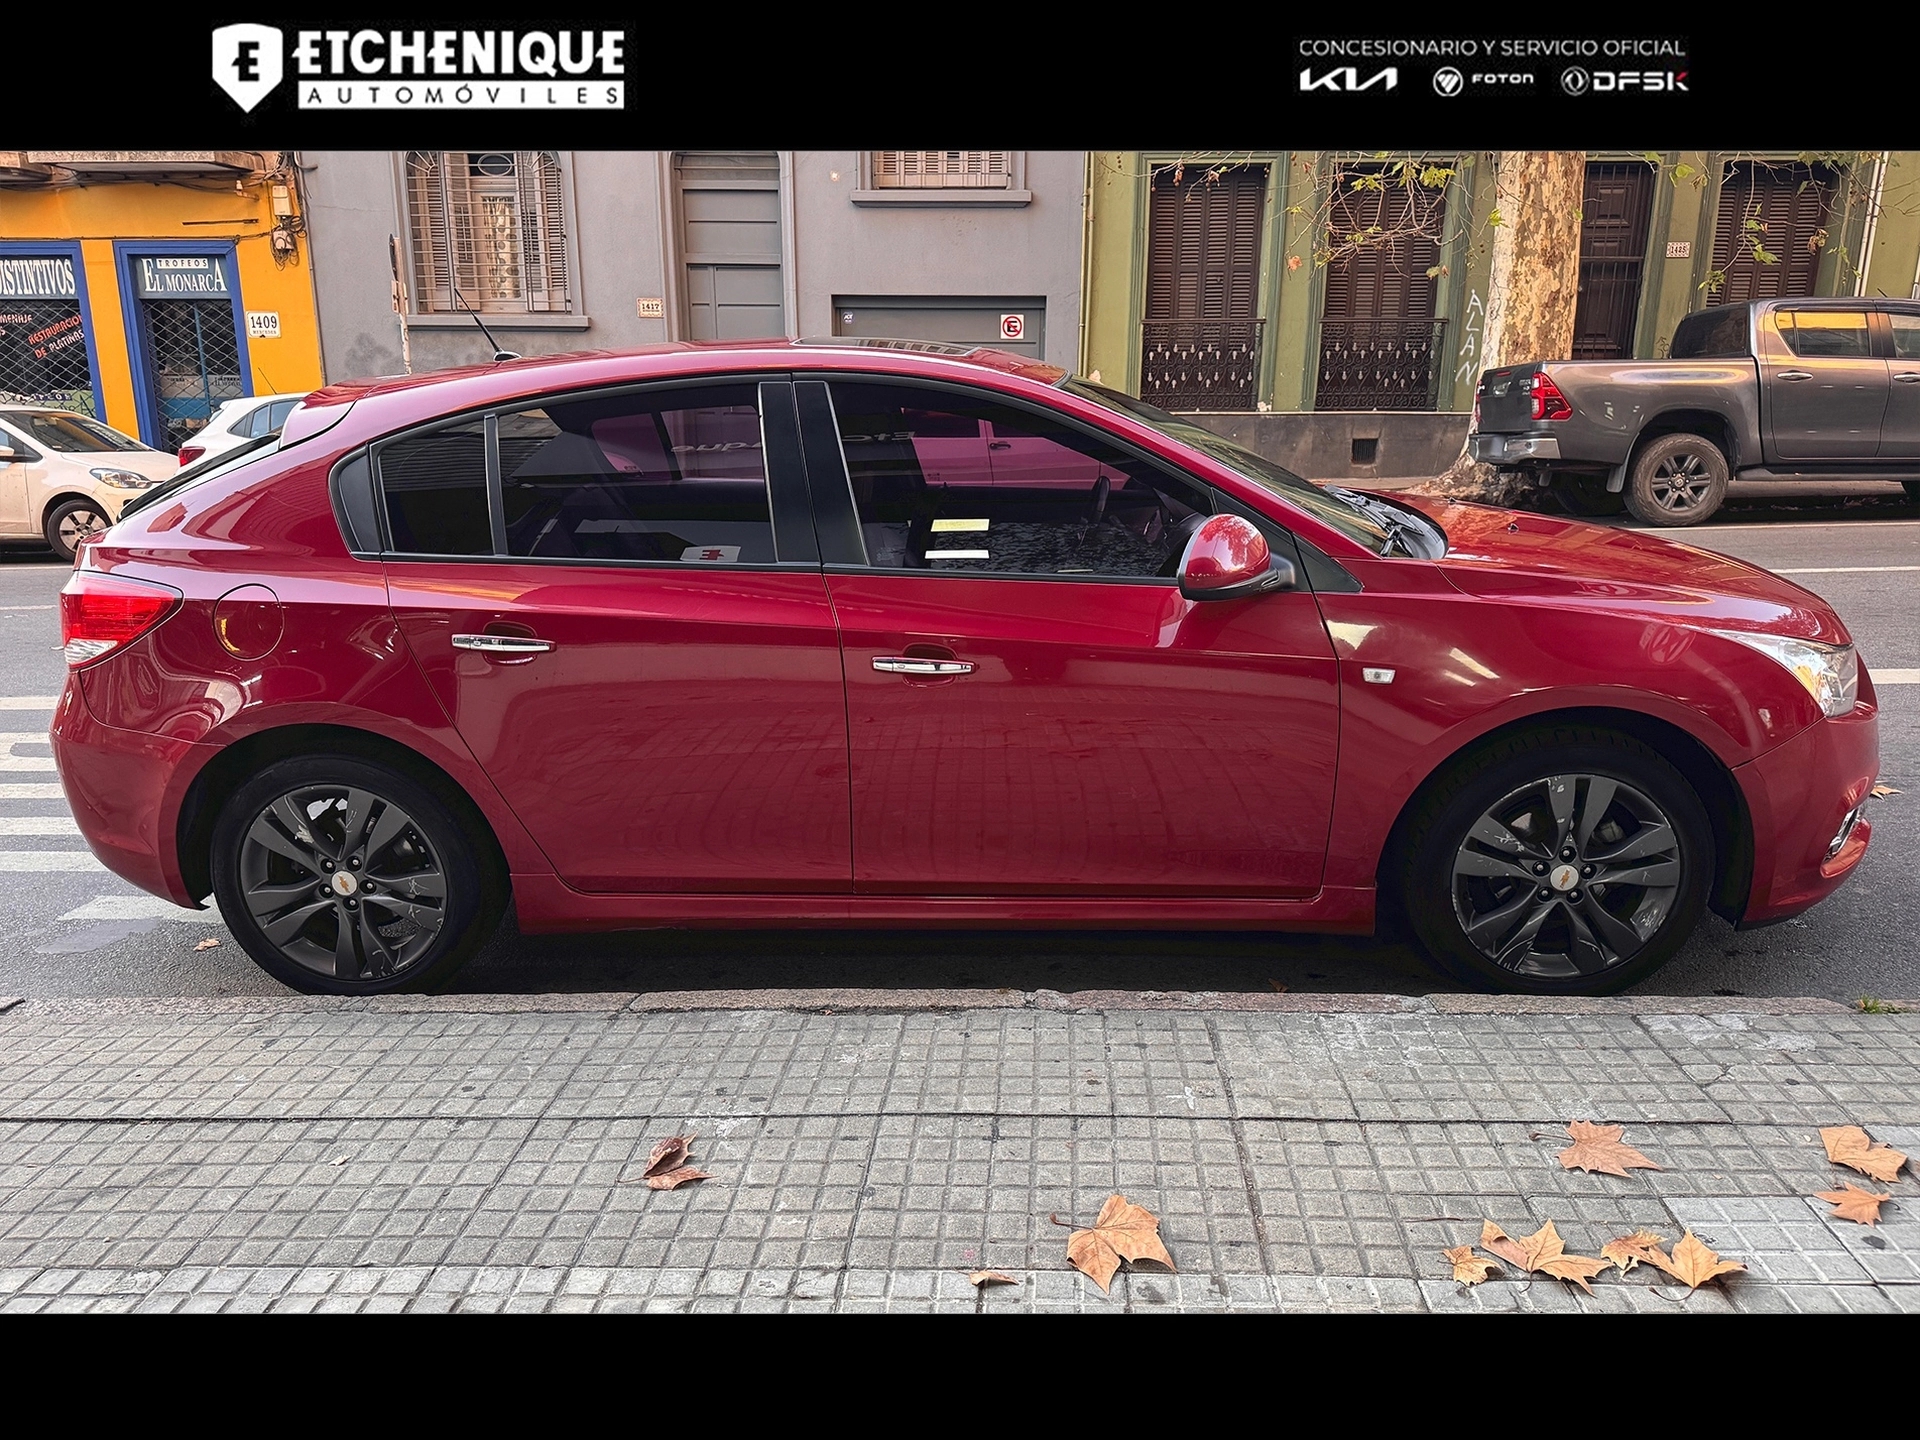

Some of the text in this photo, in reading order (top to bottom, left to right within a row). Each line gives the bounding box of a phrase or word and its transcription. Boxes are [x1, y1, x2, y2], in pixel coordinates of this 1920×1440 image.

[0, 259, 75, 295] ISTINTIVOS
[158, 259, 207, 267] TROFEOS
[165, 258, 228, 292] MONARCA
[250, 315, 277, 329] 1409
[1455, 289, 1484, 385] ALAN
[34, 329, 85, 359] DE PLATINAS
